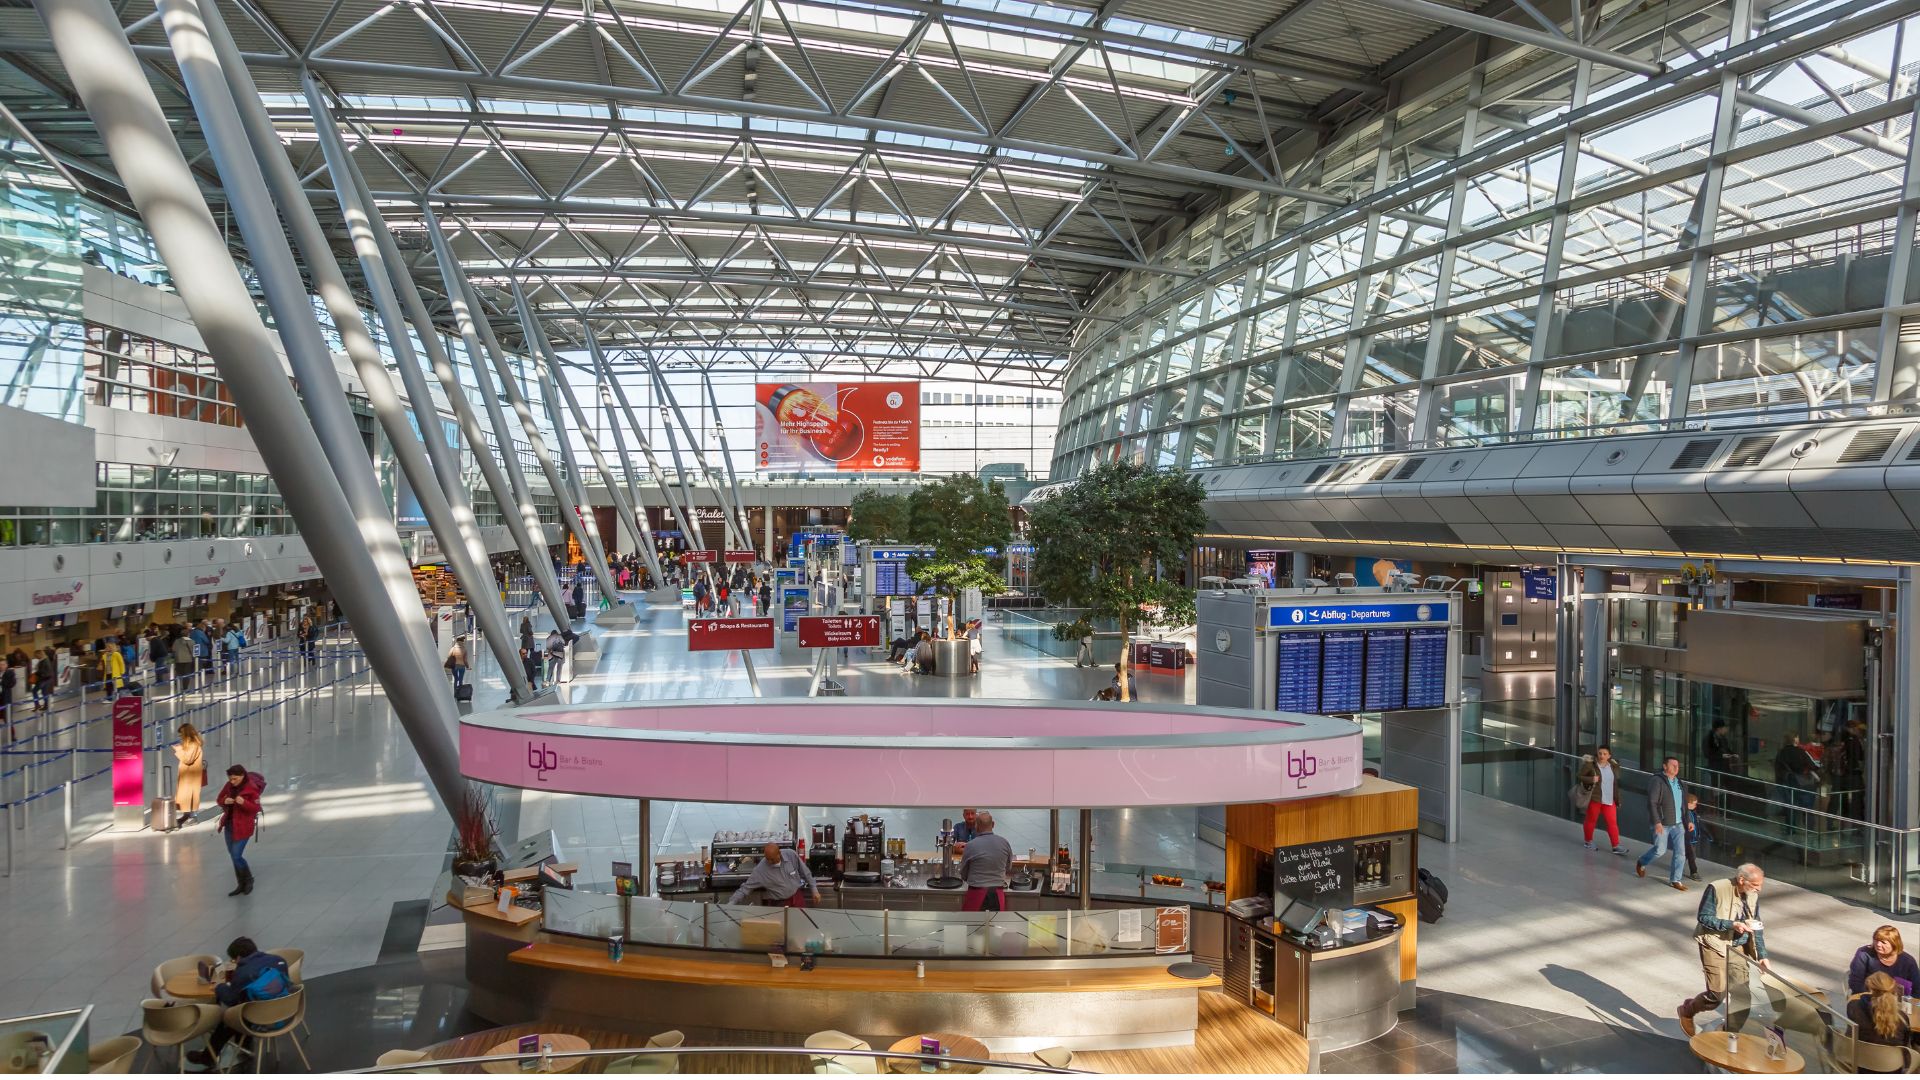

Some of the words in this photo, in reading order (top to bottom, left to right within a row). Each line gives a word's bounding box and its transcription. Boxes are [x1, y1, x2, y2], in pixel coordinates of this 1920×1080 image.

[796, 420, 828, 428] Highspeed
[1321, 610, 1346, 620] Abflug
[1351, 610, 1391, 620] Departures
[559, 755, 571, 764] Bar
[574, 756, 579, 764] &
[581, 756, 603, 766] Bistro
[1319, 758, 1330, 767] Bar
[1331, 756, 1336, 765] &
[1279, 850, 1299, 864] Guter
[1300, 848, 1322, 860] Kaffee
